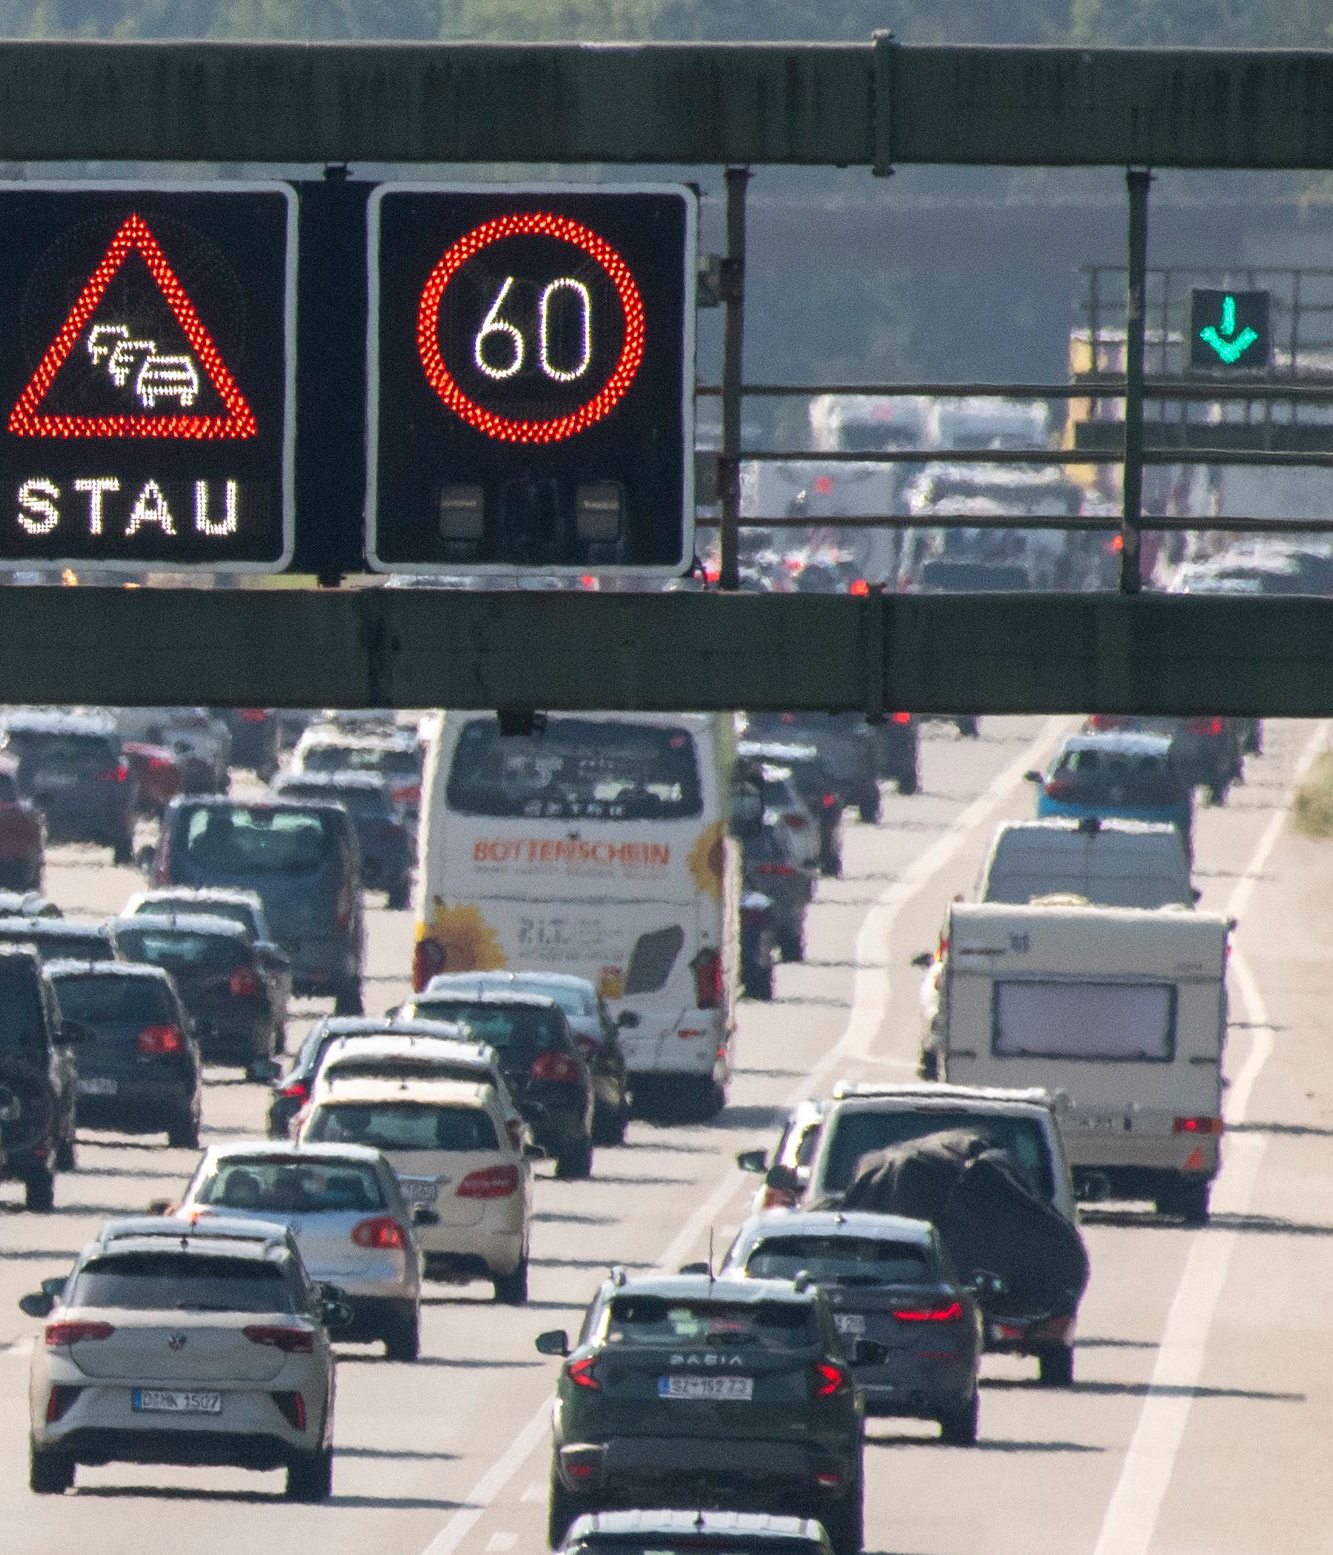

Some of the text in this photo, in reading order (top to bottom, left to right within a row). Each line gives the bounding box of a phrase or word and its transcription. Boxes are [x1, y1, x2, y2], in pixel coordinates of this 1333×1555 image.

[473, 275, 593, 382] 60
[16, 476, 239, 537] STAU
[472, 838, 670, 866] BOTTENSCHEIN
